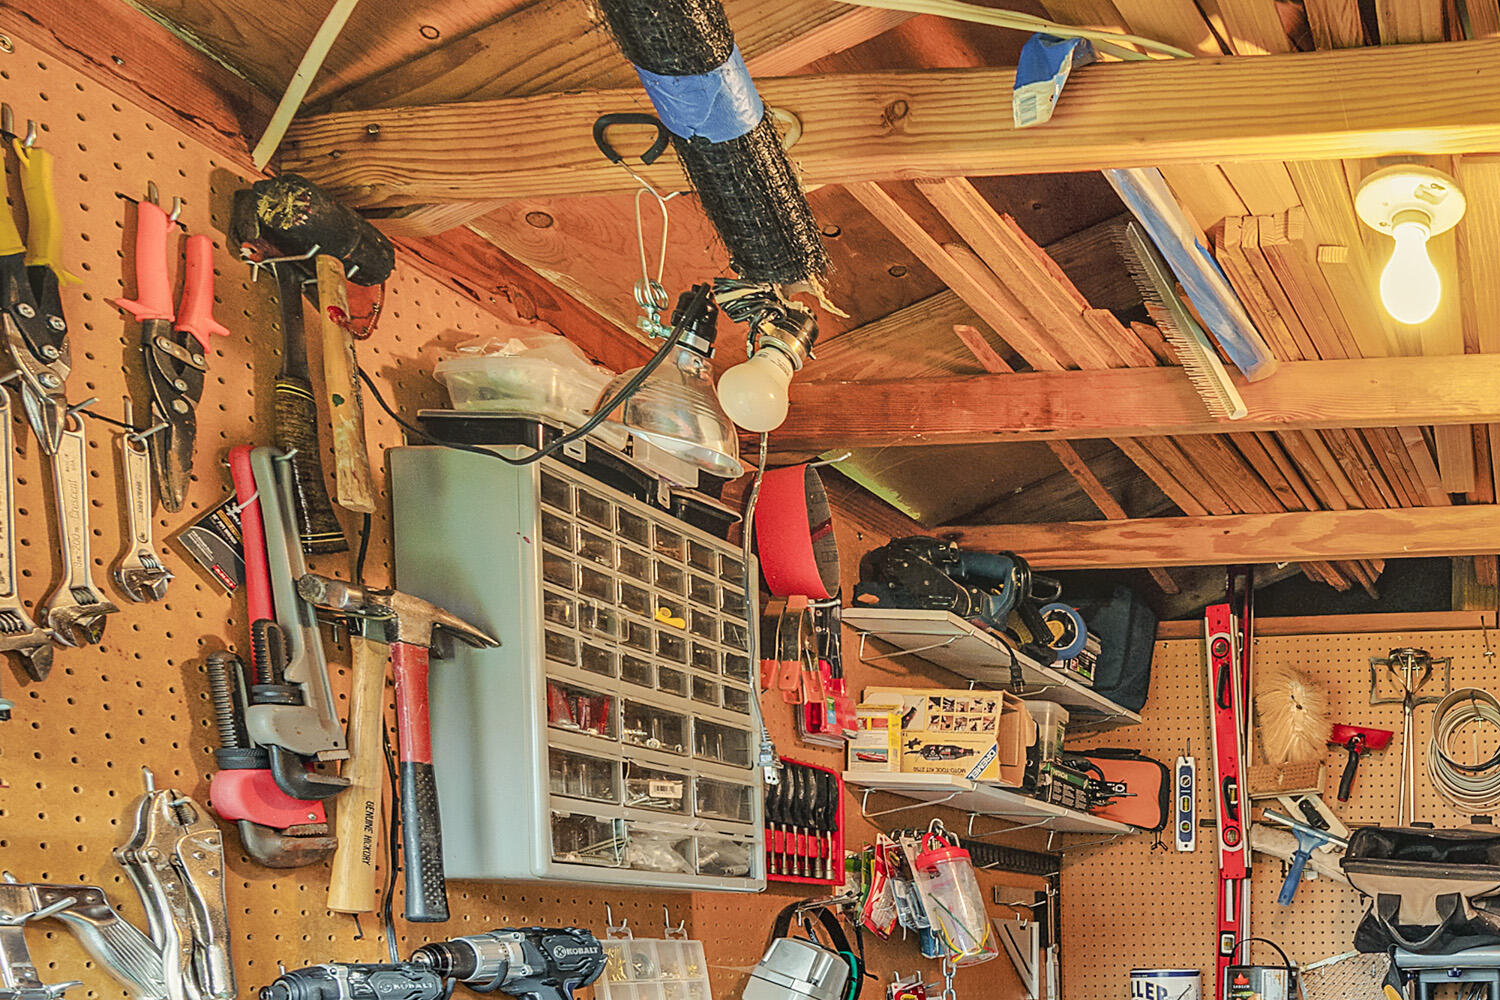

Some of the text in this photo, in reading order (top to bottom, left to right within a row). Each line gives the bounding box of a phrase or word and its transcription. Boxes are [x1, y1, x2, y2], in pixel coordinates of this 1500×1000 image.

[971, 750, 996, 777] DREMEL
[361, 800, 375, 867] GENUINE HICKORY
[565, 945, 599, 956] KOBALT
[391, 980, 433, 991] KOBALT
